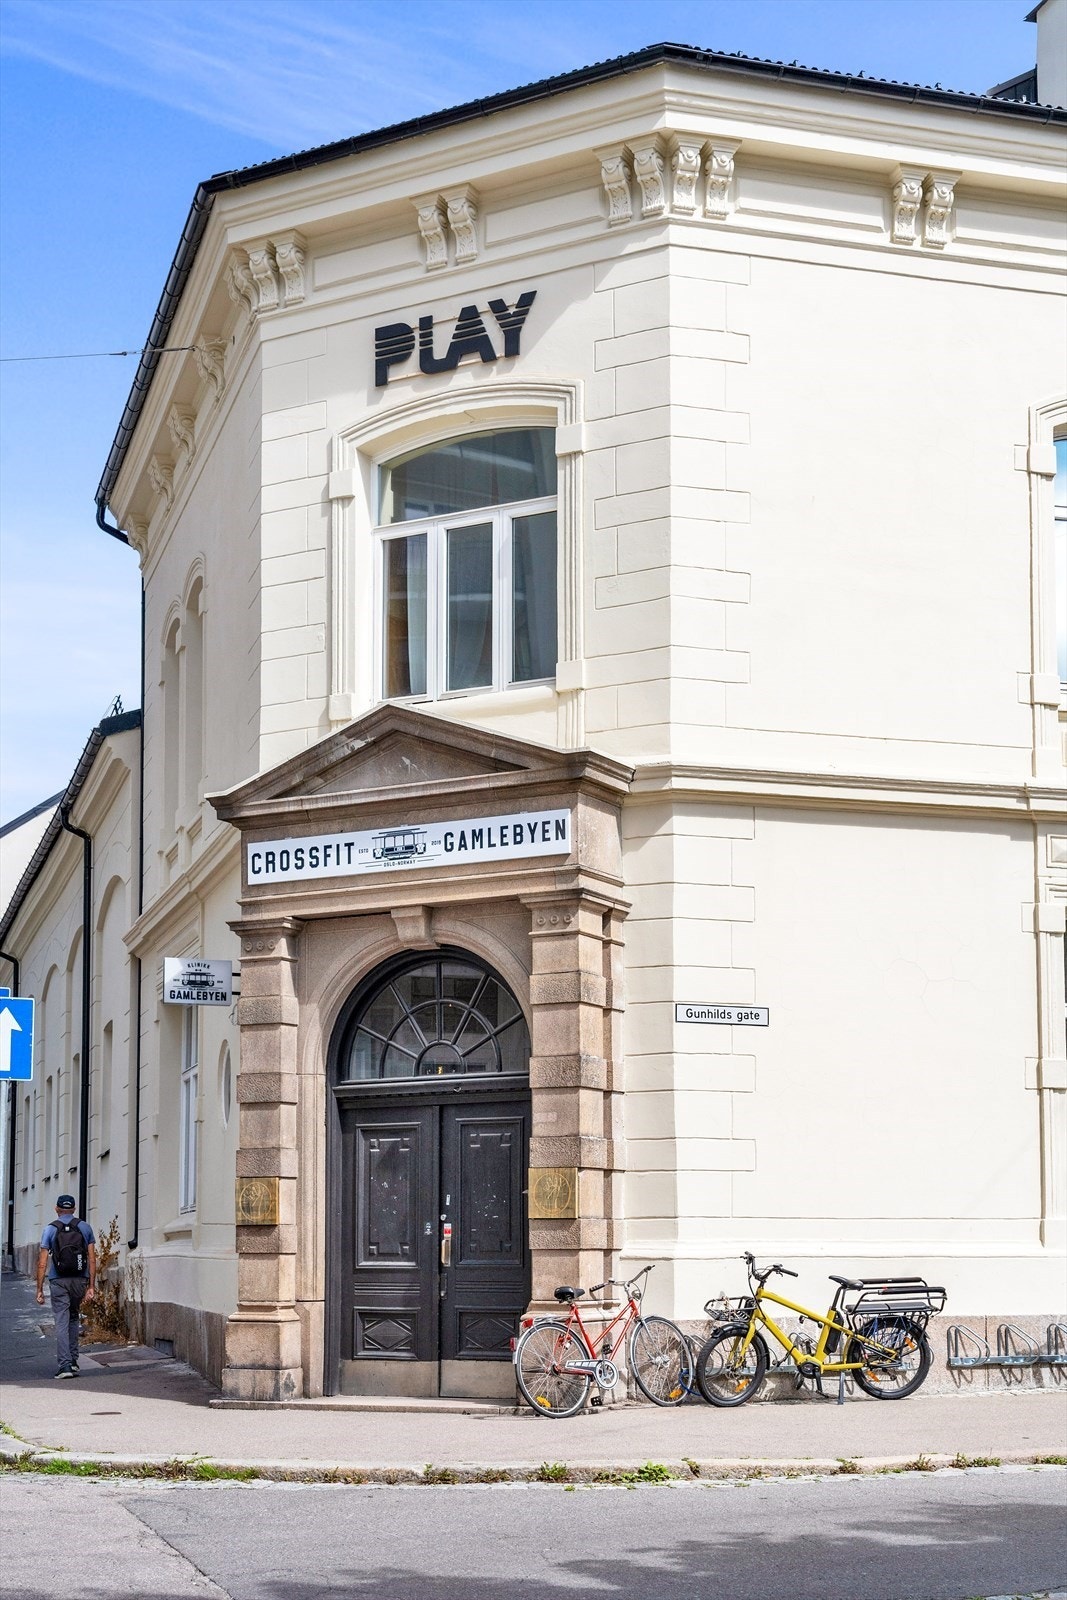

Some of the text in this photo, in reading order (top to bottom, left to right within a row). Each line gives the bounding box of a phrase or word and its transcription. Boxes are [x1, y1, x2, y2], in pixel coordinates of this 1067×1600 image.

[375, 290, 537, 387] PLAY
[251, 819, 566, 875] CROSSFIT GAMLEBYEN
[169, 990, 227, 1001] GAMLEBYEN
[685, 1008, 760, 1022] Gunhilds gate
